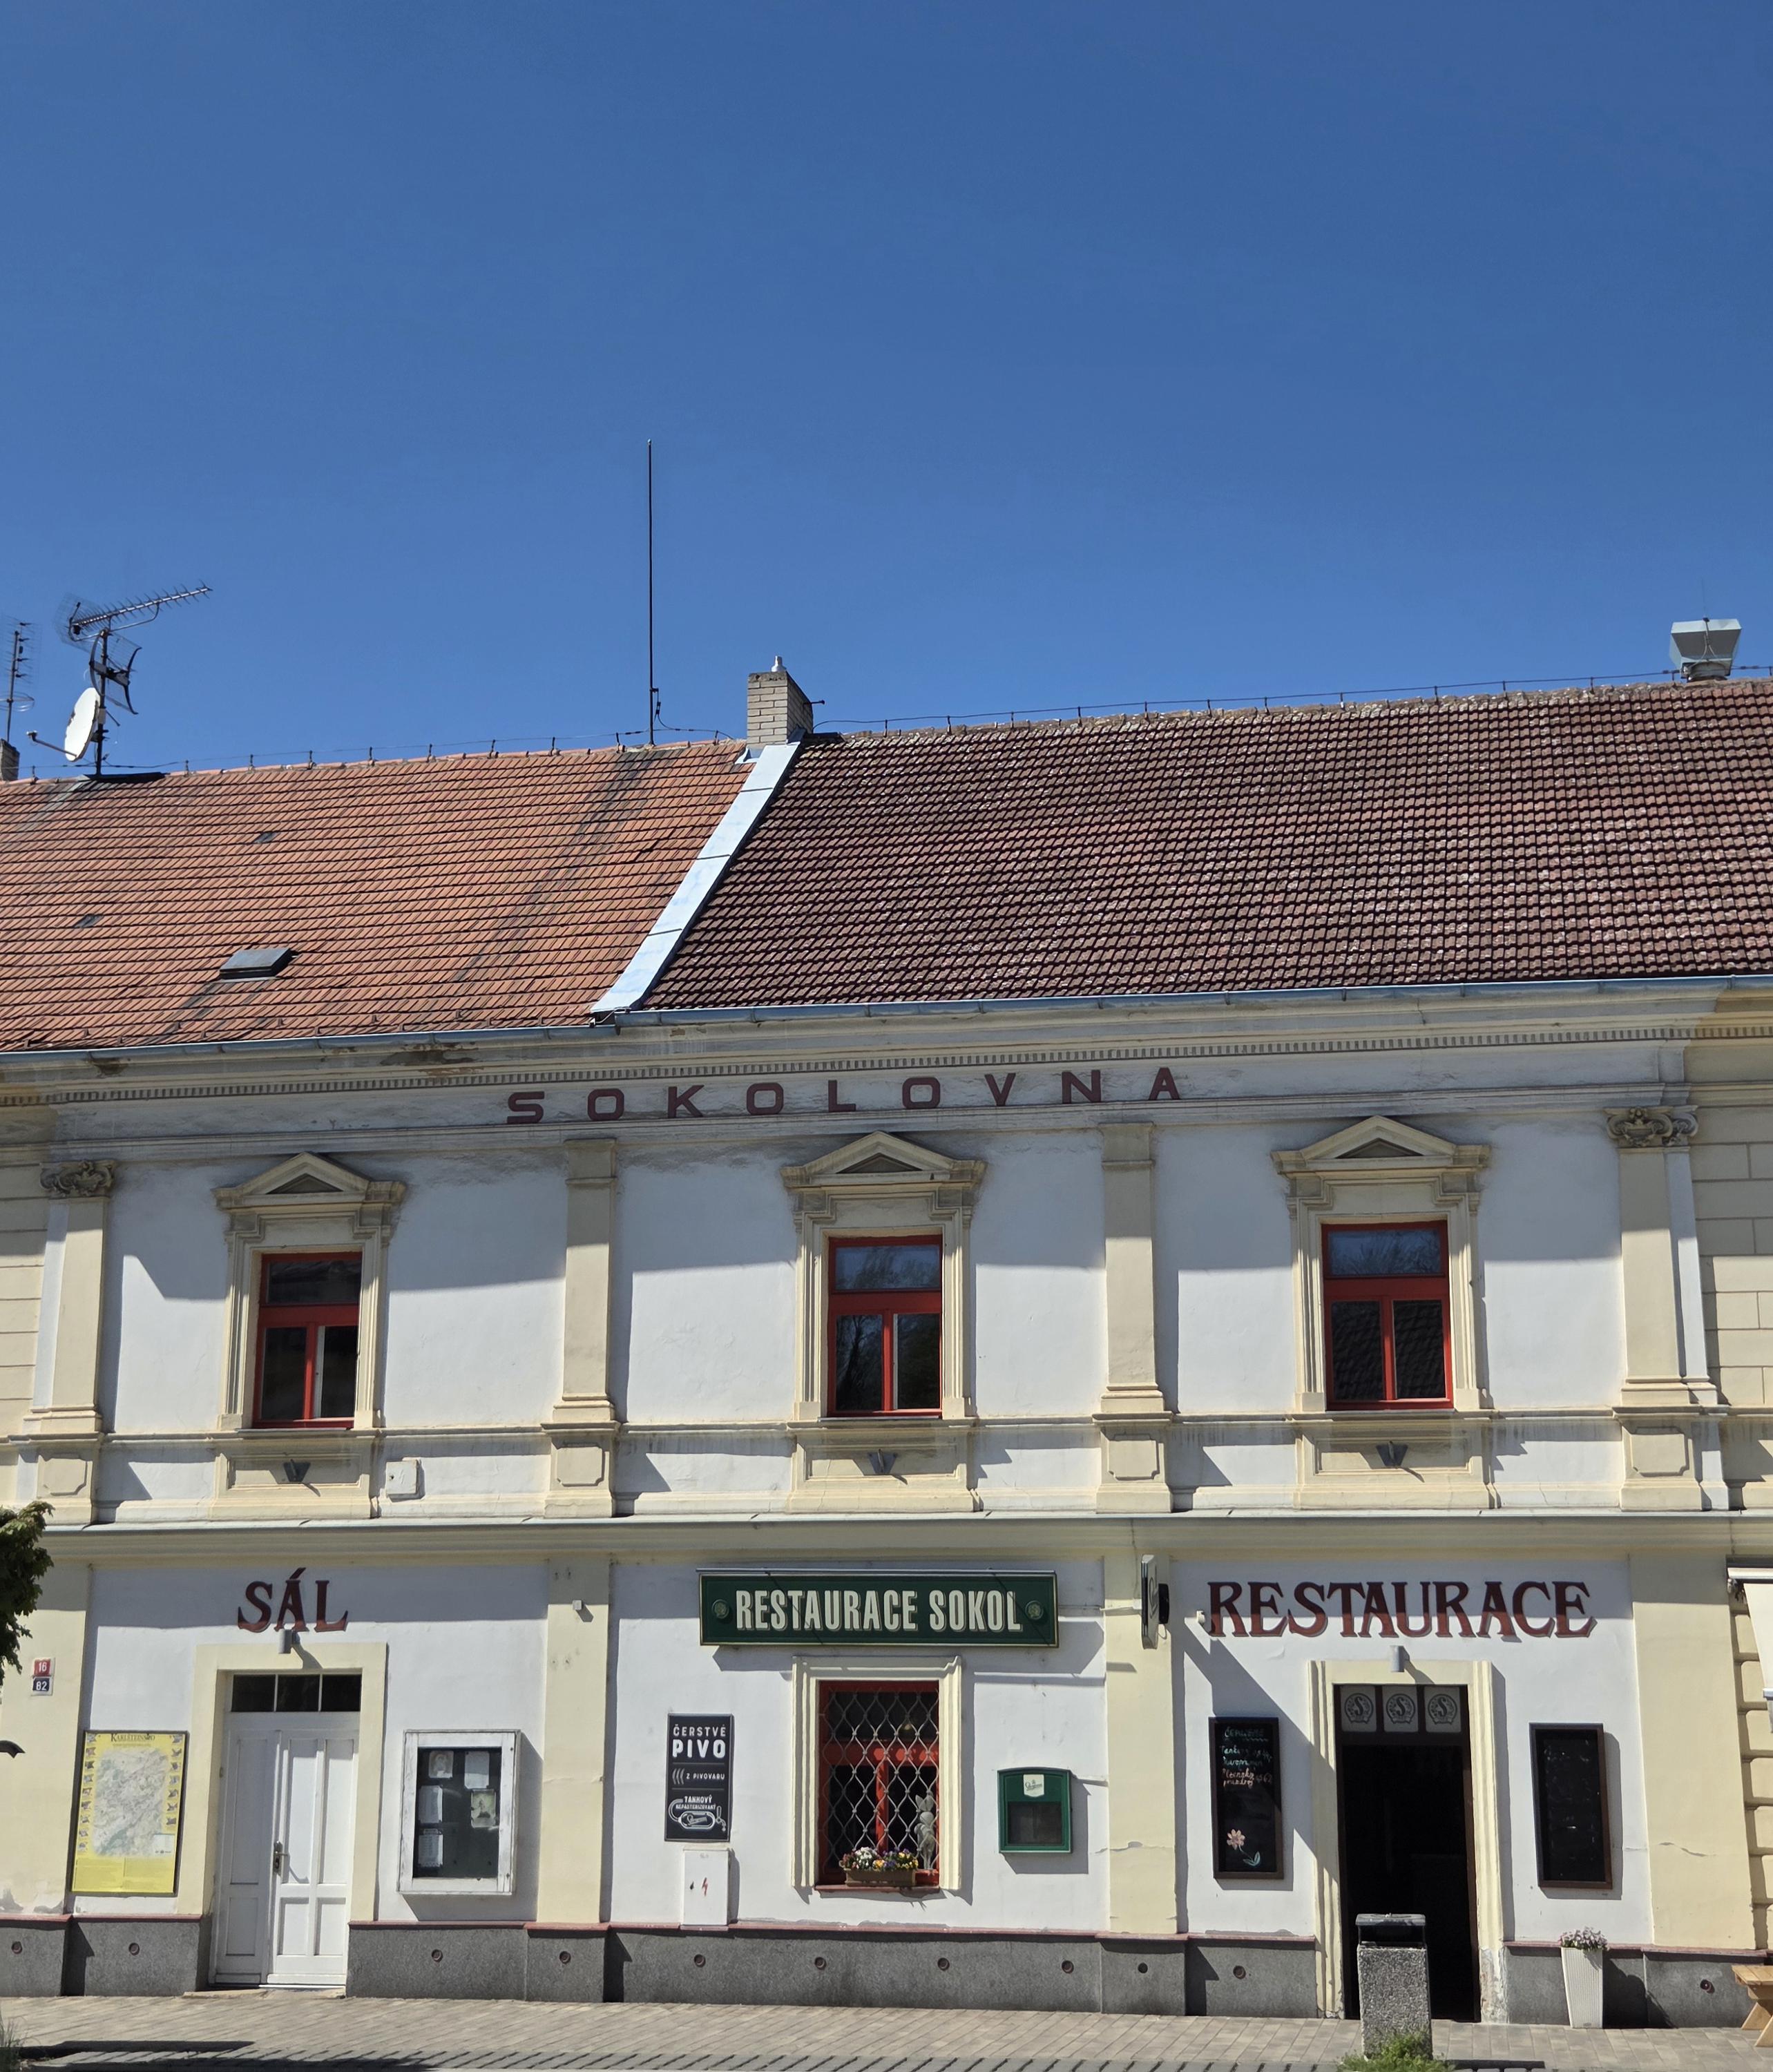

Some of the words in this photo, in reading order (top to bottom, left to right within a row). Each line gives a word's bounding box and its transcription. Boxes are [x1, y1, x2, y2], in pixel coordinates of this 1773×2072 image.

[506, 1066, 1181, 1124] SOKOLOVNA
[238, 1567, 348, 1633] SÁL
[736, 1589, 918, 1631] RESTAURACE
[929, 1590, 1024, 1631] SOKOL
[1207, 1581, 1597, 1639] RESTAURACE
[36, 1680, 47, 1691] 82
[672, 1739, 726, 1758] PIVO
[673, 1724, 727, 1737] ČERSTVÉ
